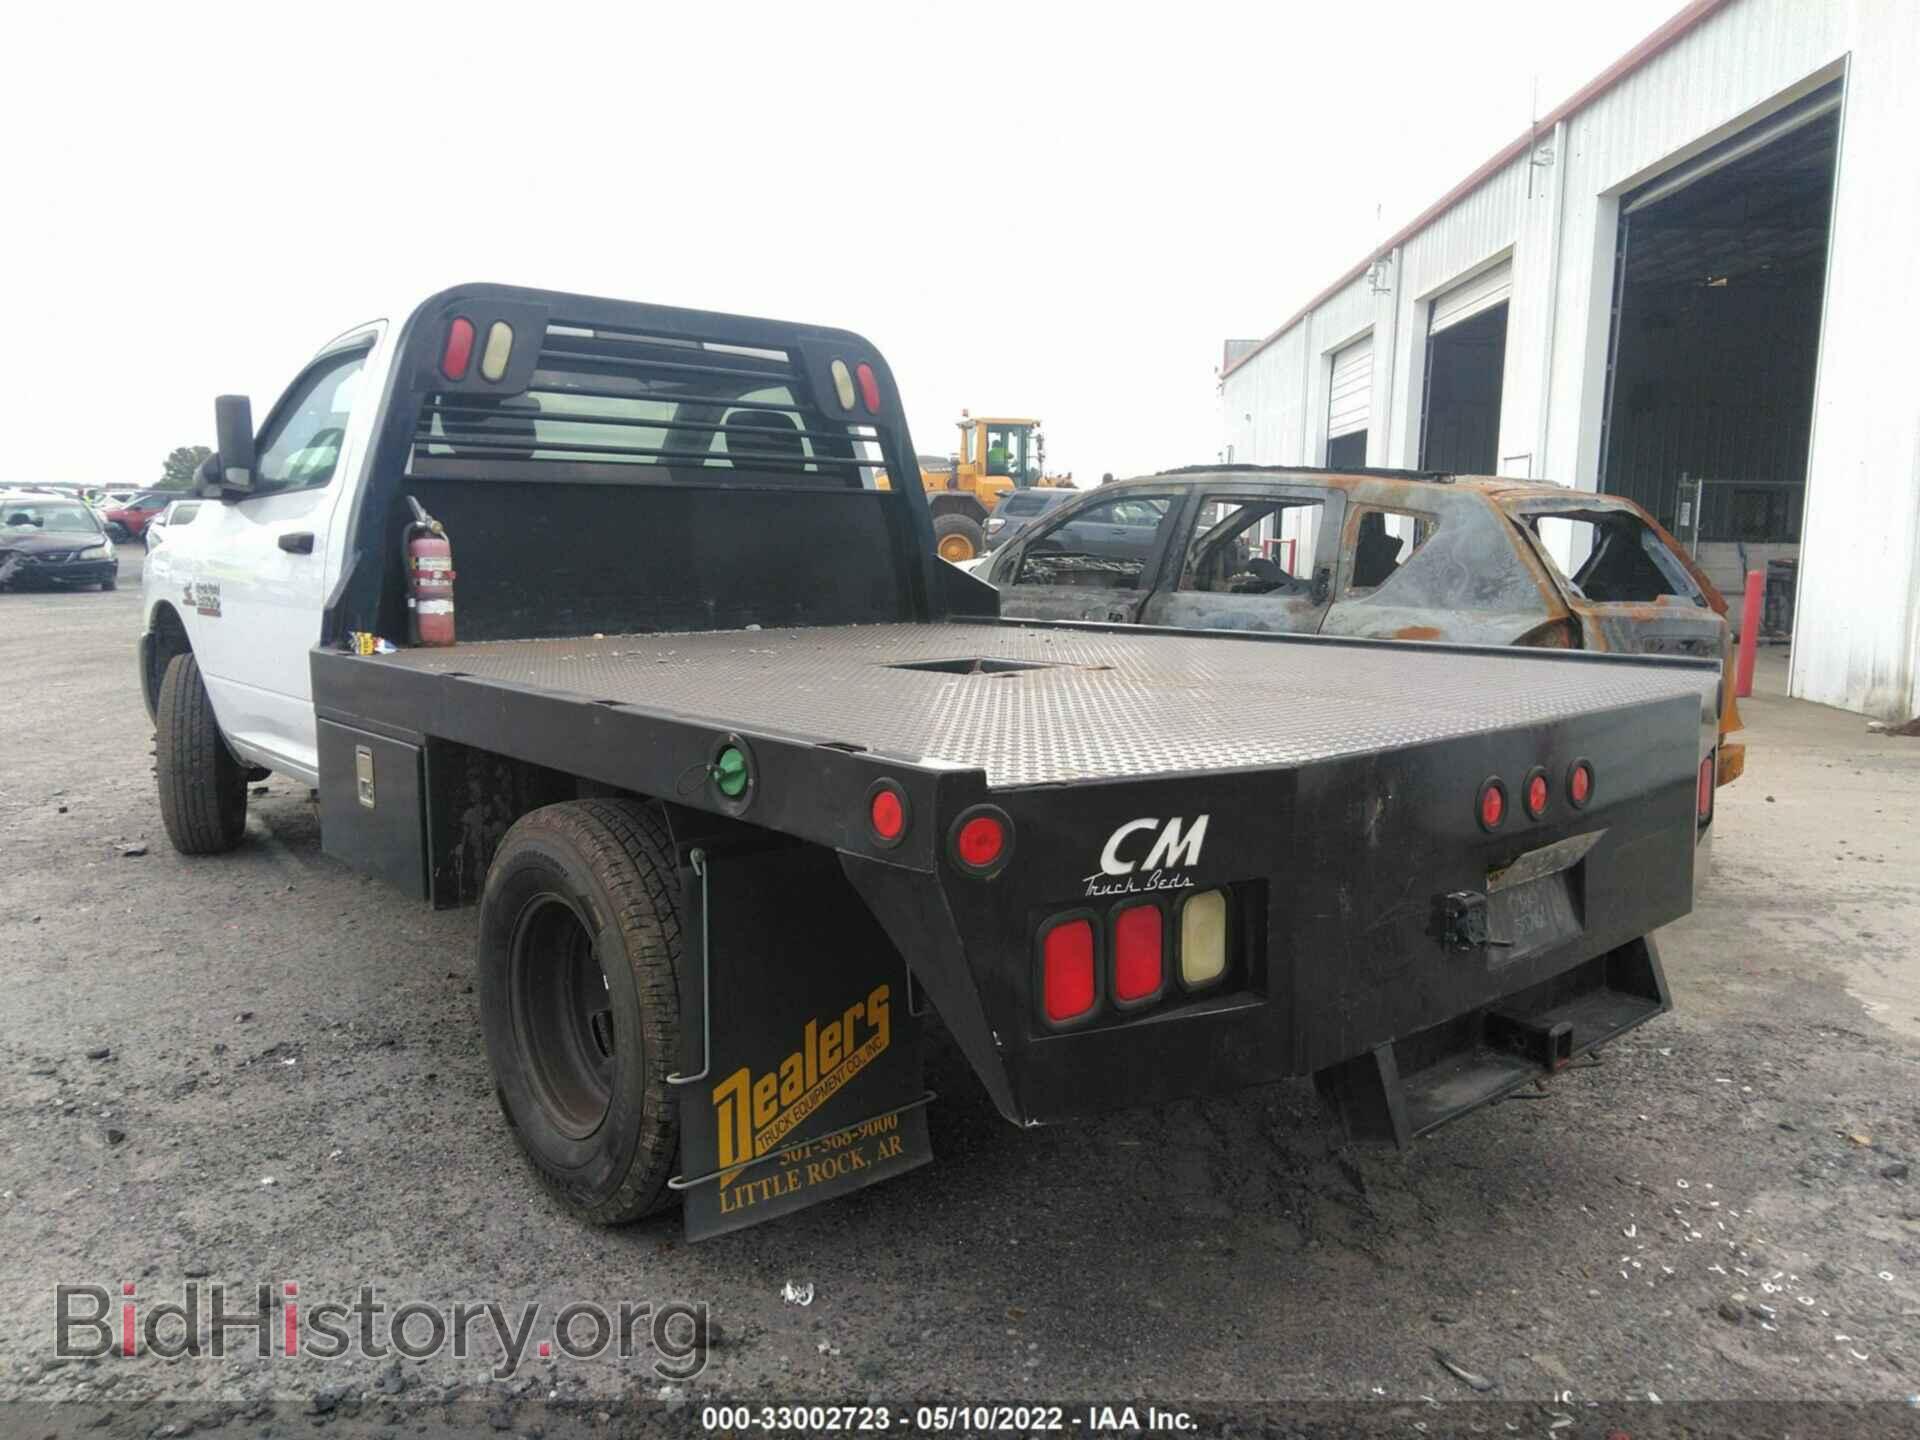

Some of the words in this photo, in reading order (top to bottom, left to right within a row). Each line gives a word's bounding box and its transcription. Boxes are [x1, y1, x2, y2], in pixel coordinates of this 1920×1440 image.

[1082, 871, 1142, 897] Truck
[1143, 868, 1195, 891] Beds
[1099, 814, 1210, 875] CM
[712, 983, 891, 1190] Dealers
[757, 1112, 796, 1151] TRUCK
[793, 1067, 846, 1120] EQUIPMENT
[719, 1168, 801, 1214] LITTLE
[877, 1135, 904, 1160] AR
